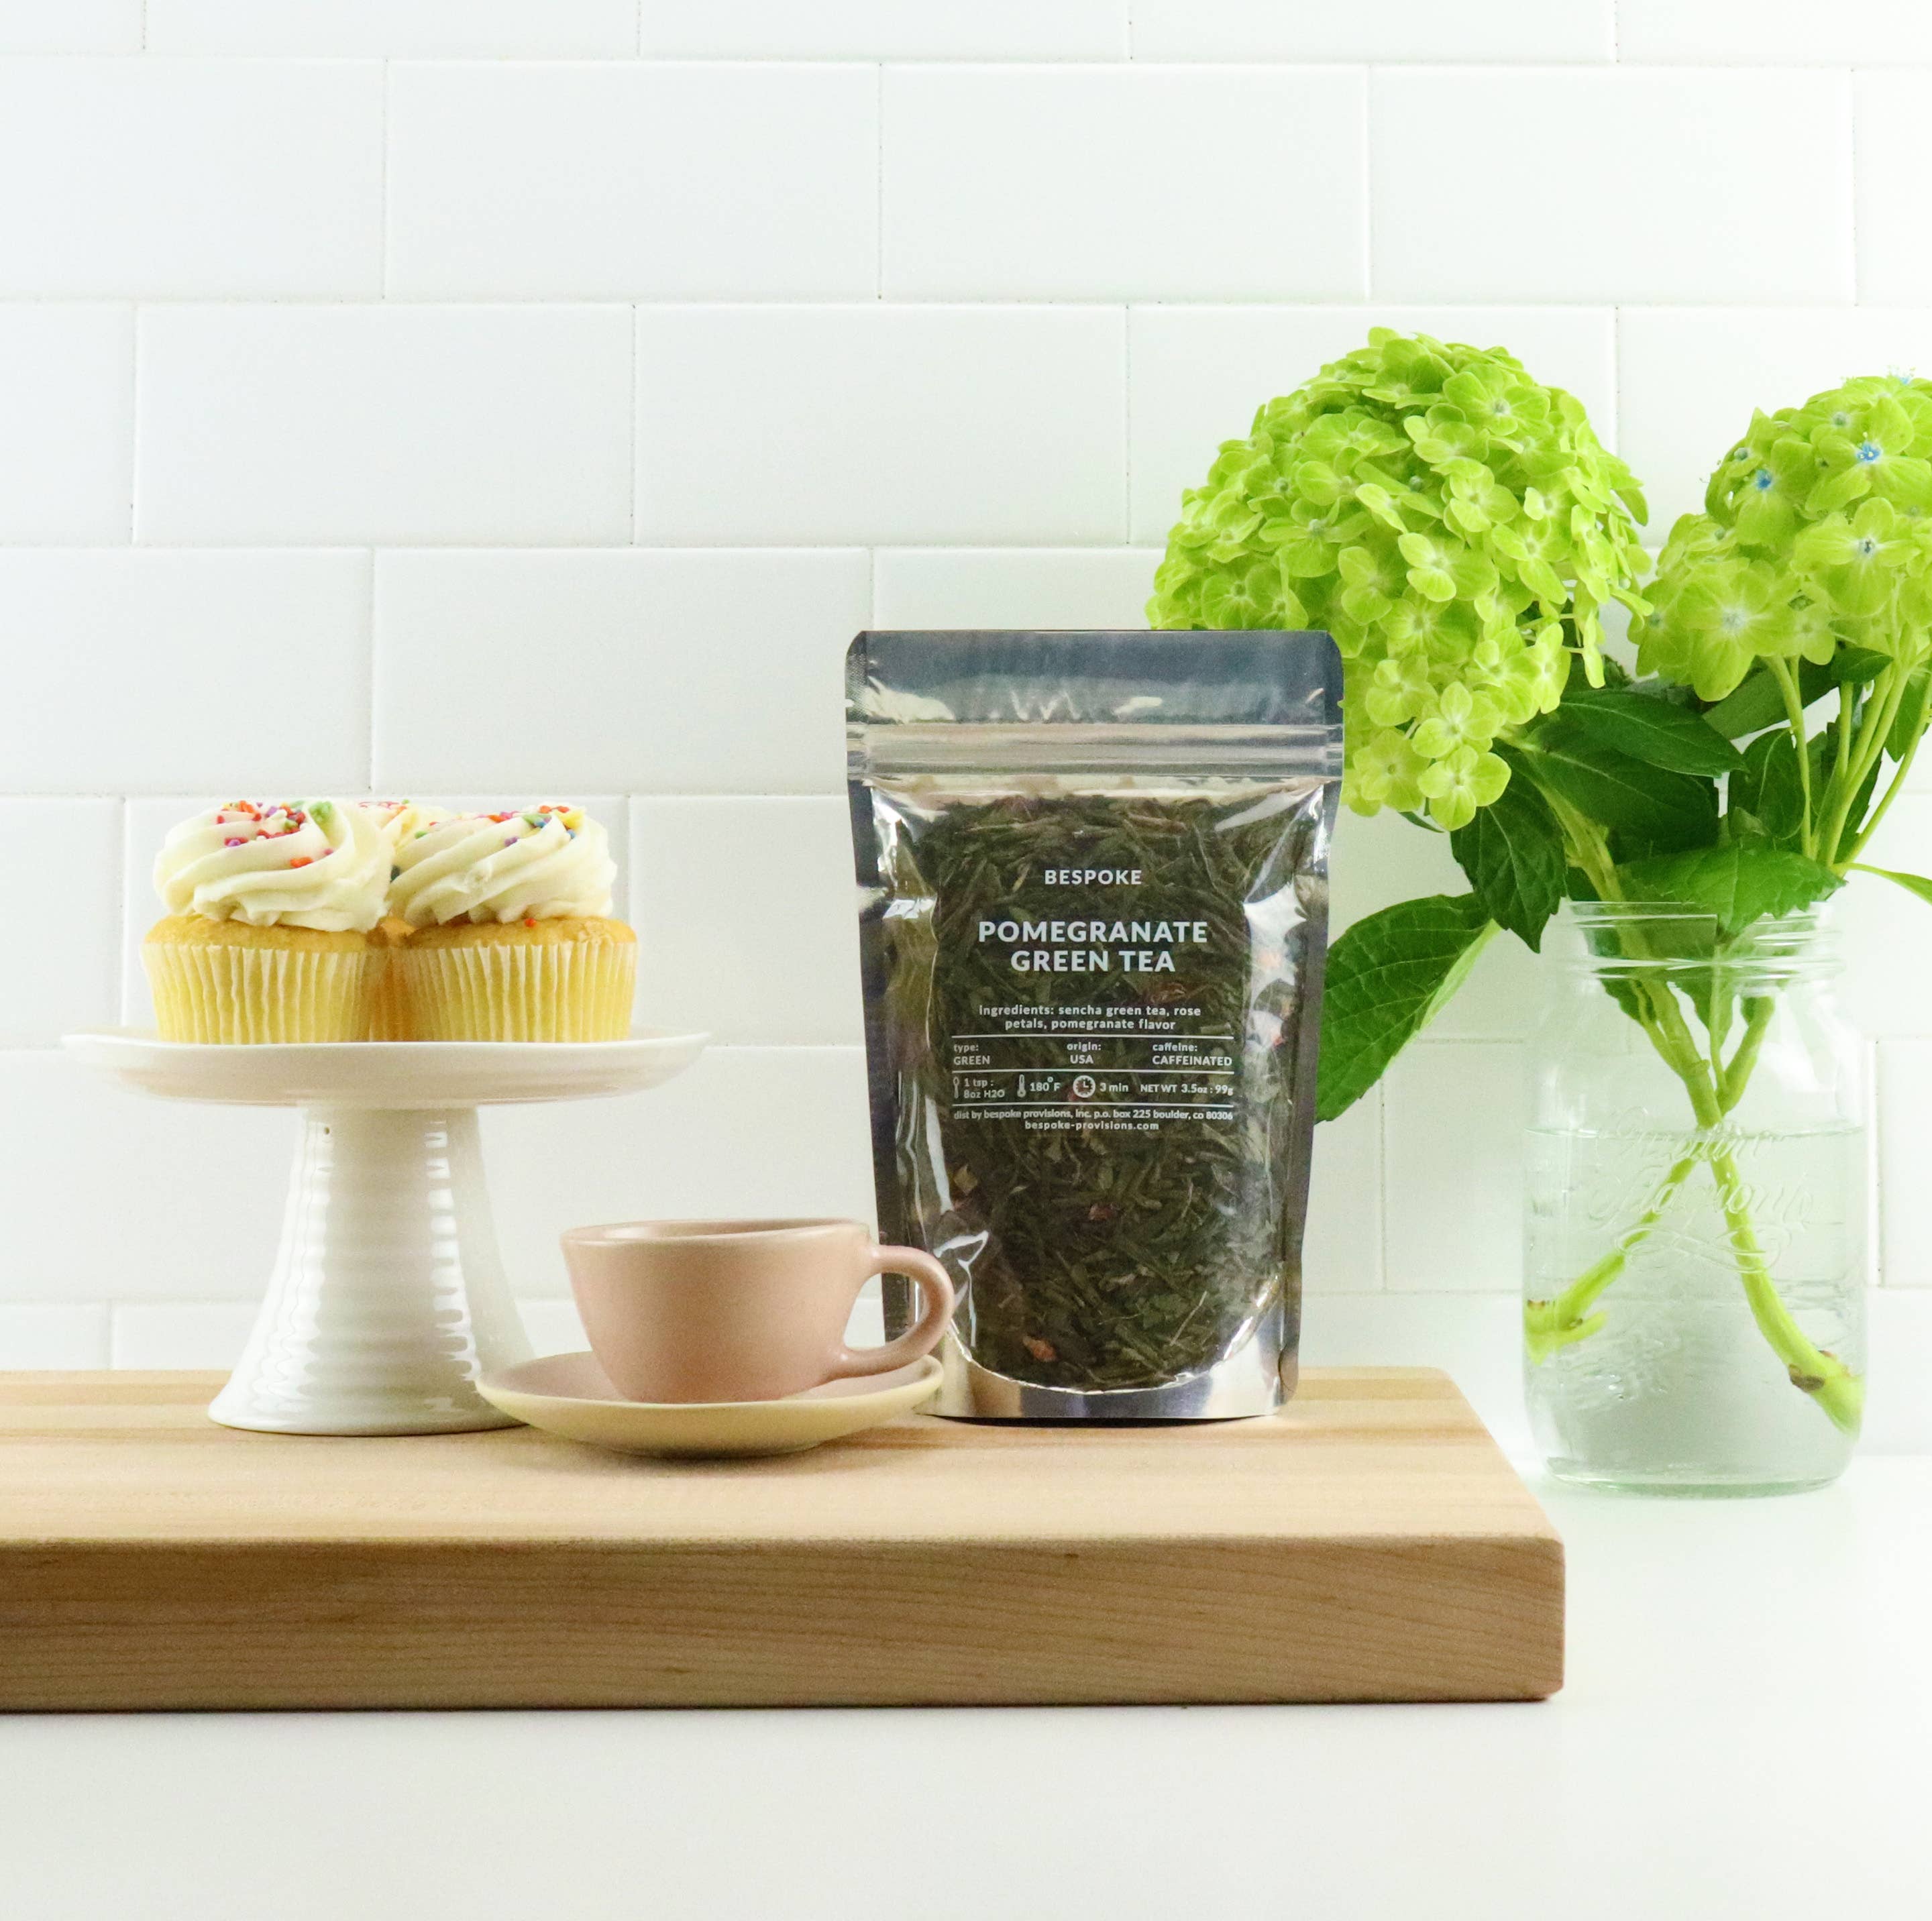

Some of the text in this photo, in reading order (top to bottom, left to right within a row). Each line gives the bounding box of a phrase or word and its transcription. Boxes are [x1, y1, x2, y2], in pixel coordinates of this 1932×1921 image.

[1045, 870, 1142, 885] BESPOKE
[979, 922, 1208, 942] POMEGRANATE
[1011, 951, 1175, 972] GREEN TEA
[1059, 1005, 1102, 1015] sencha
[1106, 1007, 1141, 1017] green
[1146, 1006, 1169, 1016] tea,
[1174, 1007, 1201, 1016] rose
[1005, 1018, 1175, 1030] petals, pomegranate flavor
[954, 1044, 979, 1053] type:
[1067, 1042, 1101, 1052] origin:
[1152, 1042, 1197, 1052] caffeine:
[953, 1055, 990, 1065] GREEN
[1070, 1055, 1093, 1064] USA
[1152, 1056, 1232, 1066] CAFFEINATED
[964, 1079, 969, 1087] 1
[1100, 1083, 1128, 1092] 3 min
[963, 1090, 981, 1098] 8oz
[1140, 1084, 1159, 1093] NET
[1161, 1085, 1177, 1093] WT
[1181, 1085, 1208, 1093] 3.5oz
[1216, 1085, 1233, 1095] 99g
[971, 1110, 982, 1119] by
[984, 1110, 1021, 1119] bespoke
[1023, 1109, 1073, 1119] provisions,
[1114, 1109, 1130, 1118] box
[1133, 1109, 1150, 1119] 225
[1153, 1110, 1191, 1119] boulder,
[1206, 1111, 1232, 1119] 80306
[1025, 1121, 1159, 1130] bespoke-provisions.com
